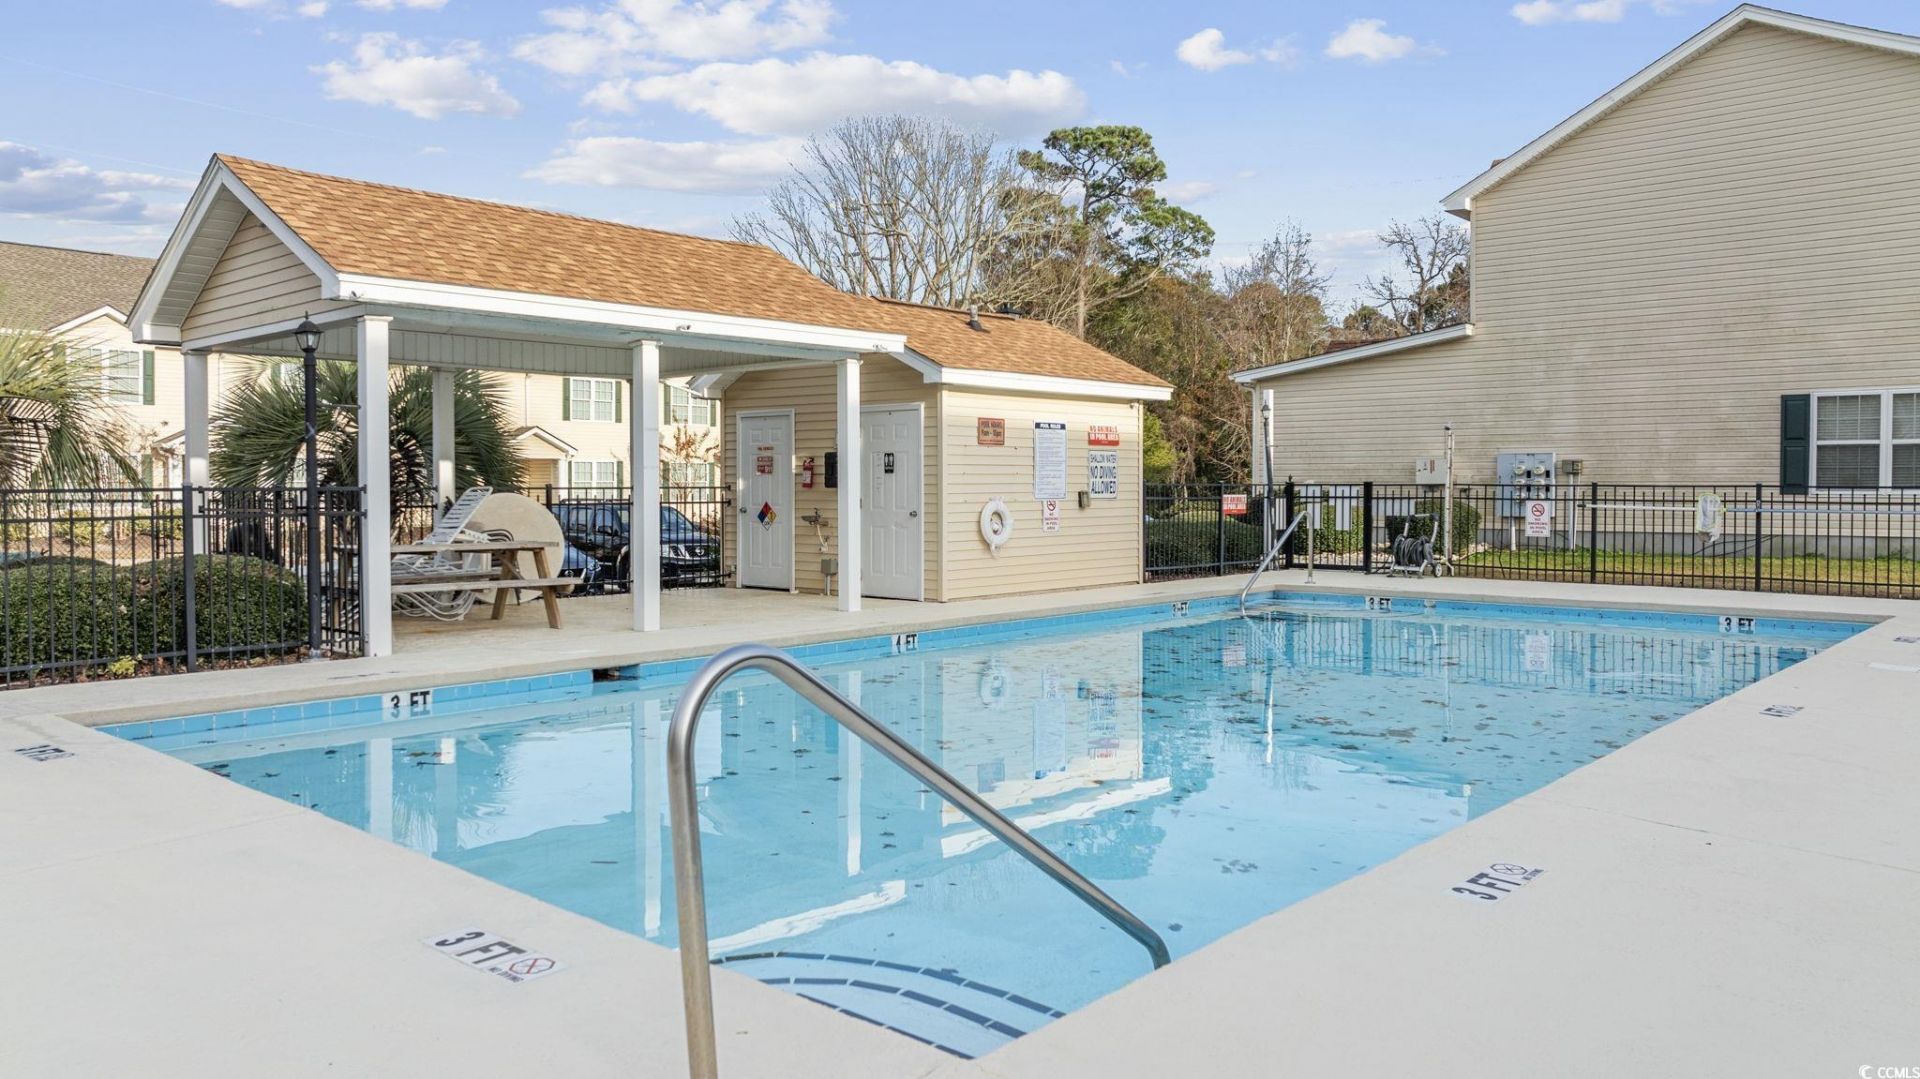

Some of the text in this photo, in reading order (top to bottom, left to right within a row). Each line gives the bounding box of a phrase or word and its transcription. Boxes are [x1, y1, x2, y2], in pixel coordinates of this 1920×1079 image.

[1097, 425, 1117, 433] ANIMALS
[1090, 454, 1117, 464] SHALLOW WATER
[1090, 465, 1116, 479] NO DIVING
[1090, 480, 1116, 494] ALLOWED
[1738, 617, 1754, 627] FT
[905, 633, 918, 645] FT
[390, 690, 431, 709] 3 FT
[1451, 872, 1522, 900] 3 FT
[434, 931, 528, 965] 3 FT
